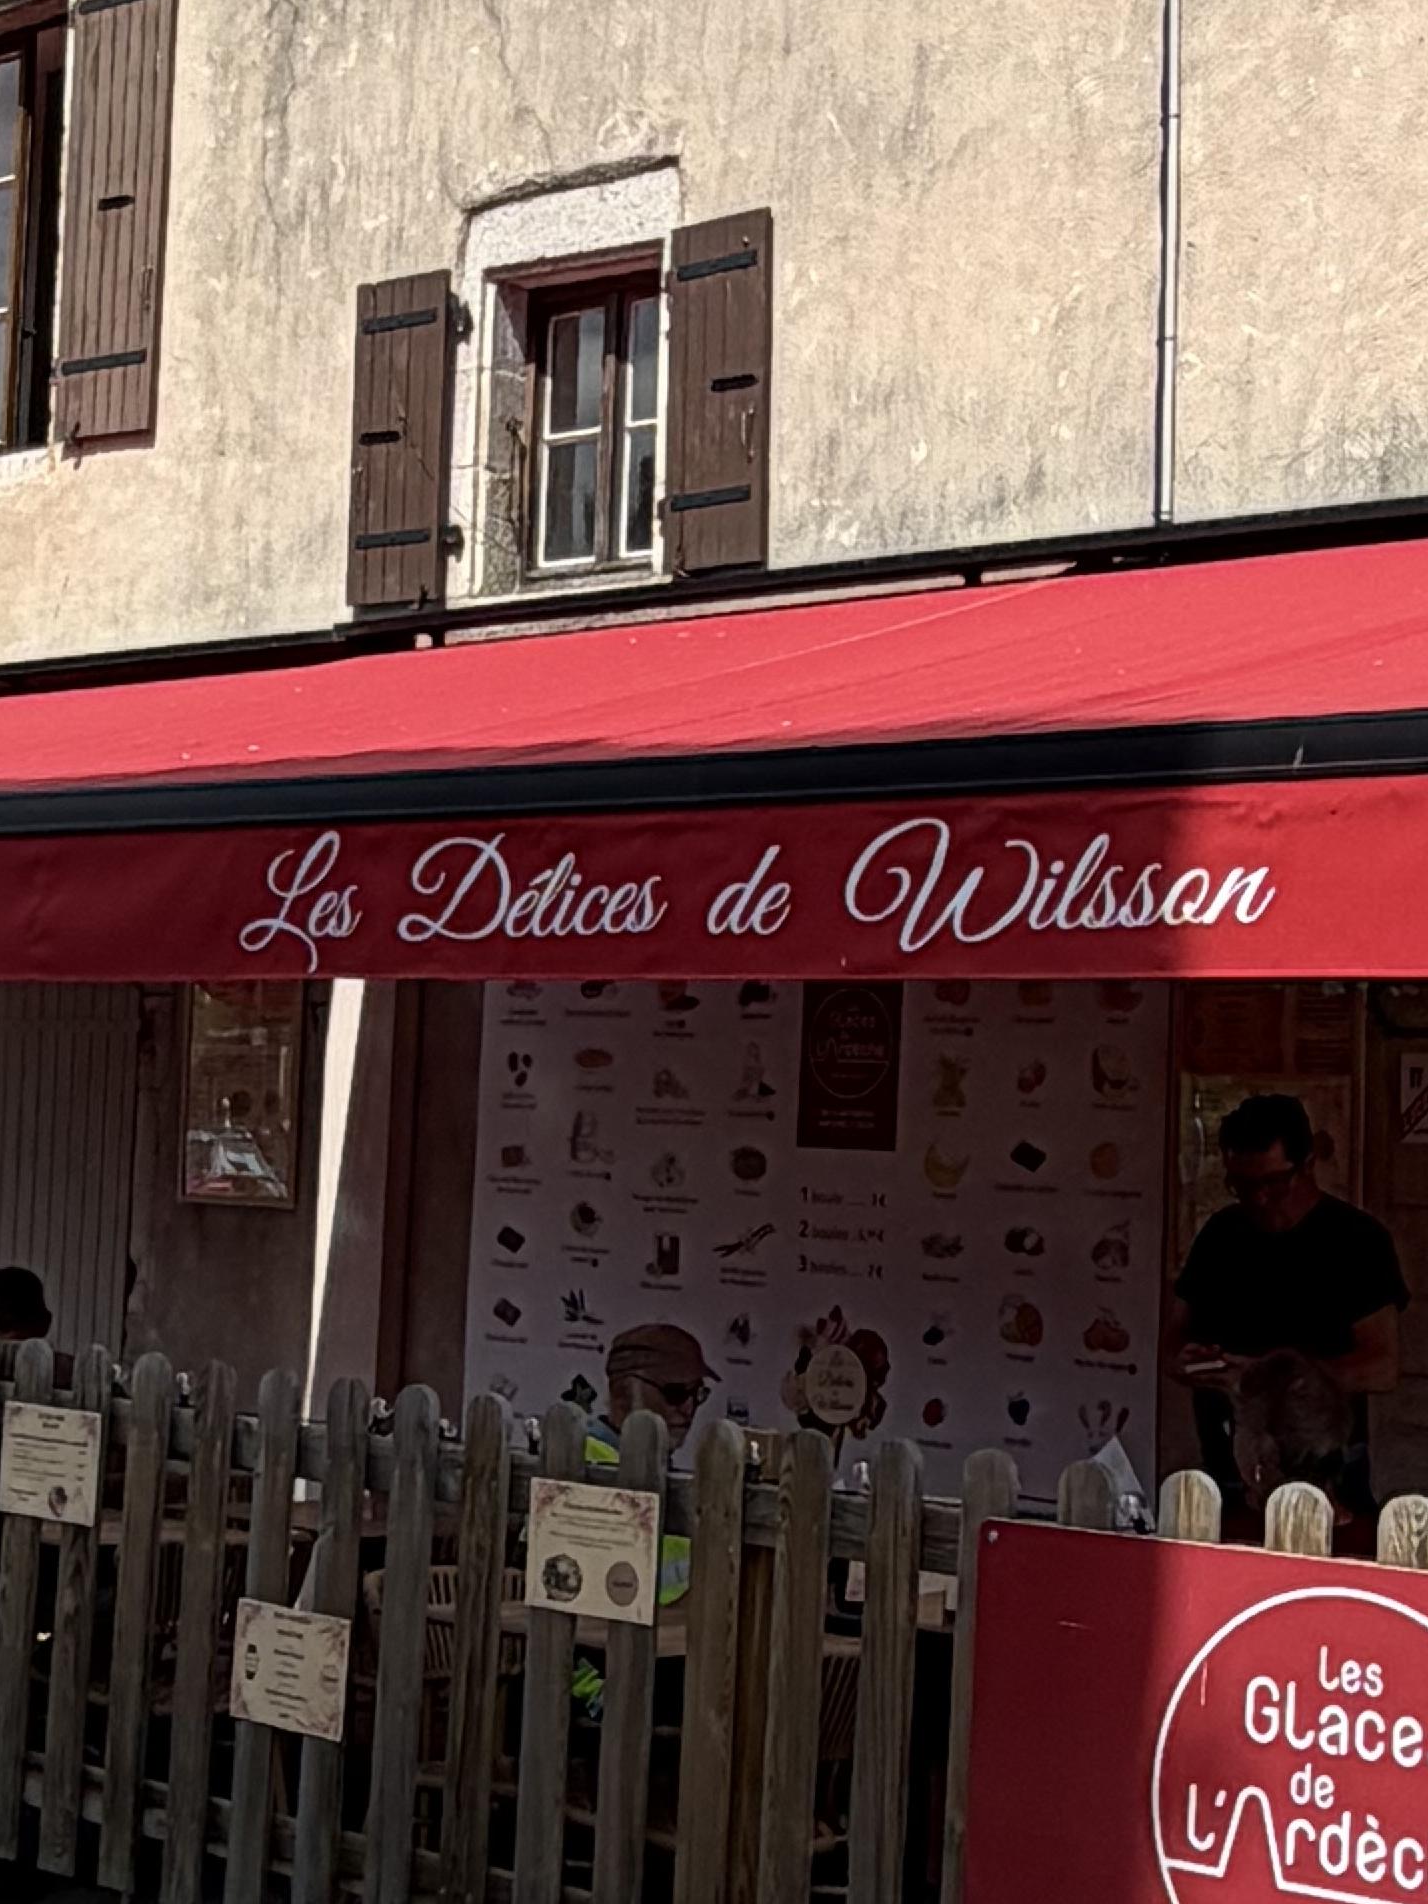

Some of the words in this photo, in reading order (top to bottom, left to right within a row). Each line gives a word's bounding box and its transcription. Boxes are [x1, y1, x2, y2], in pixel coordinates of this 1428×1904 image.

[239, 830, 363, 973] Les
[398, 832, 667, 942] Délices
[706, 844, 792, 936] de
[844, 817, 1276, 953] Wilsson
[1288, 1763, 1335, 1809] de
